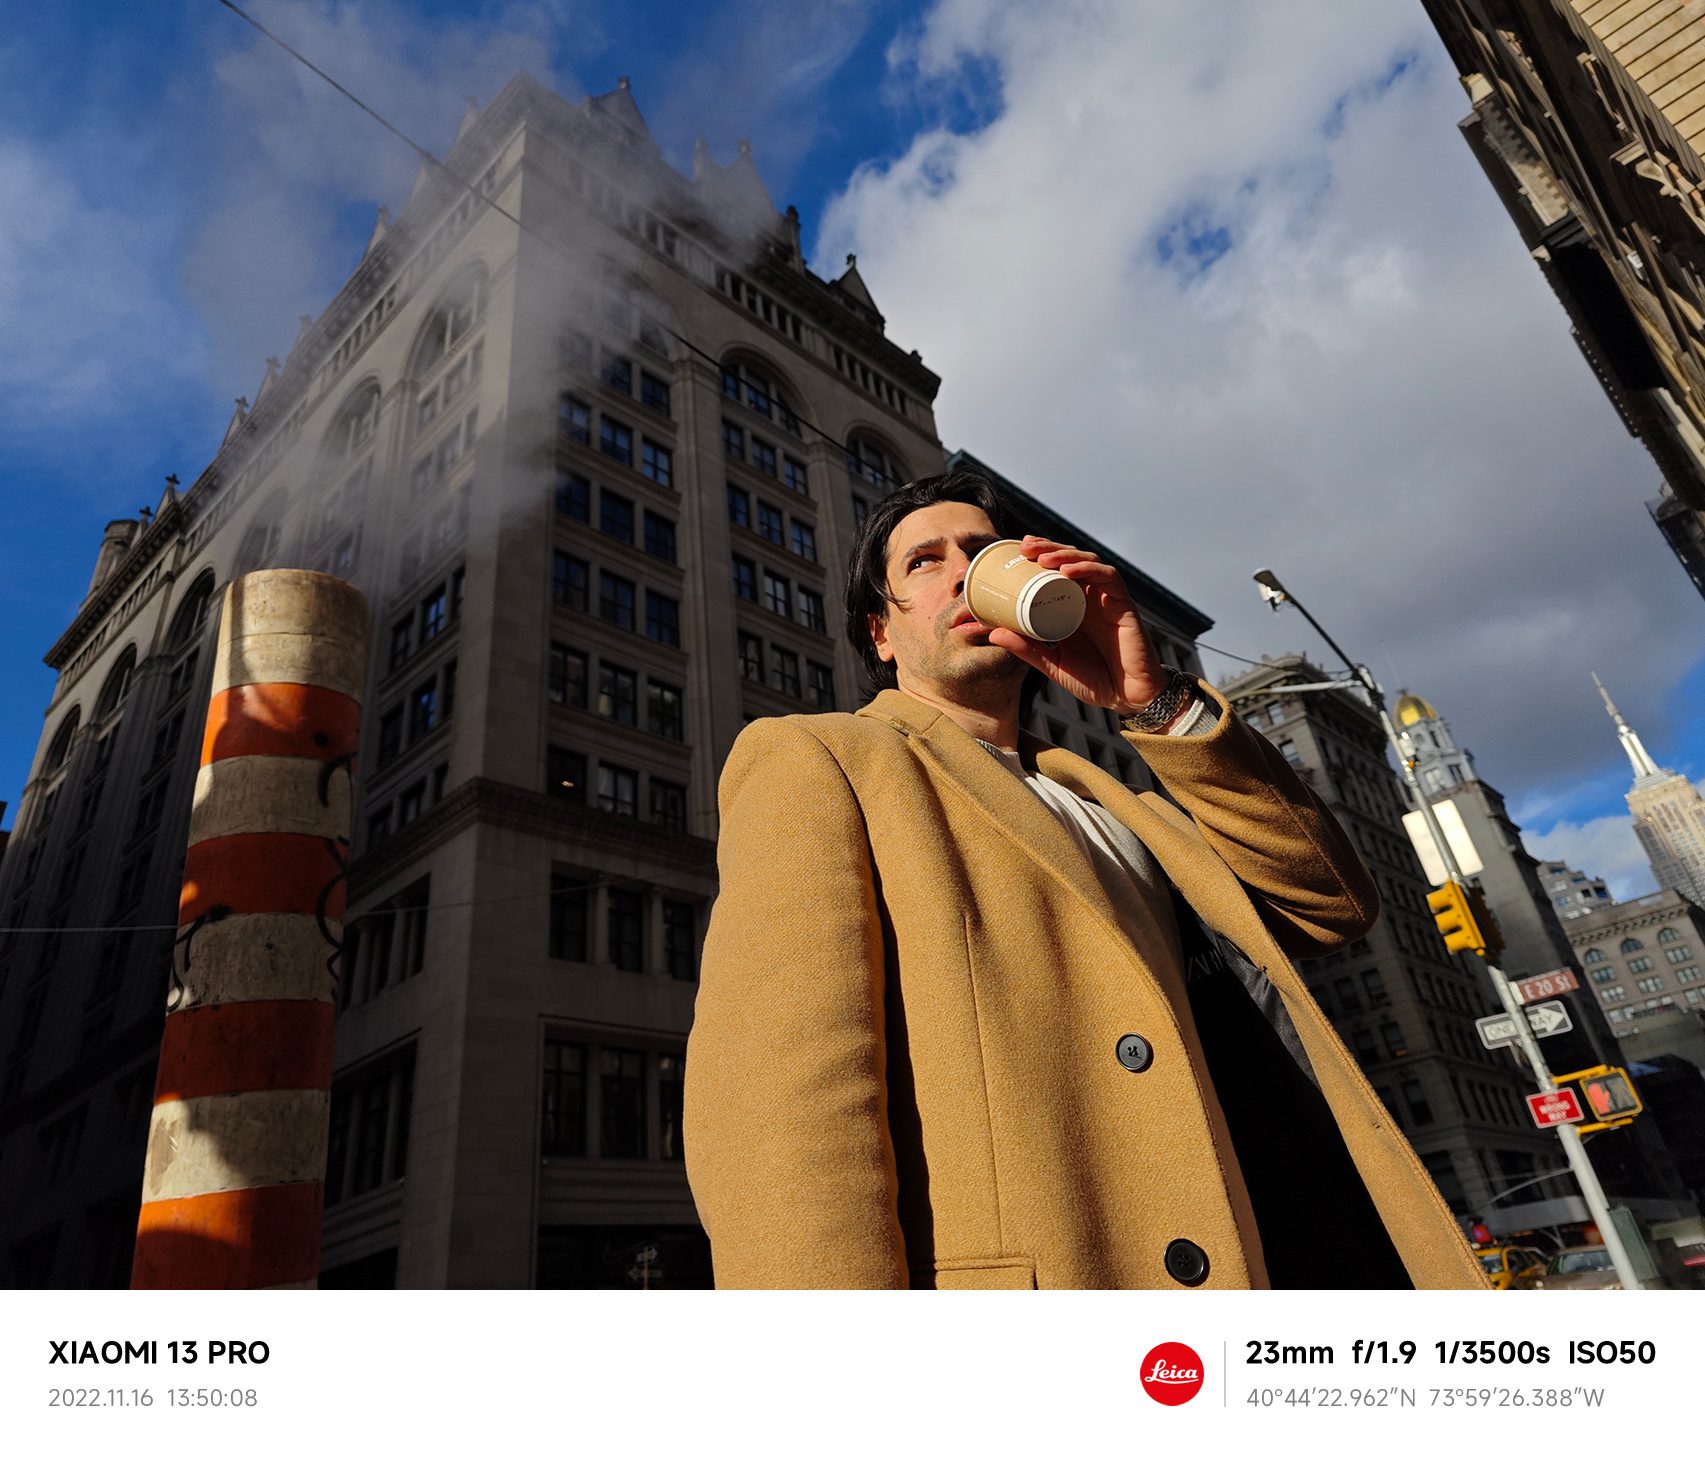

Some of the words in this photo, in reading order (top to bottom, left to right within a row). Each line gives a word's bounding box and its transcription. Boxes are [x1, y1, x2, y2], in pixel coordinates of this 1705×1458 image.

[1524, 984, 1536, 999] E
[1535, 979, 1553, 996] 20
[1555, 975, 1572, 991] St
[1539, 1100, 1571, 1115] WRONG
[1547, 1110, 1567, 1122] WAY
